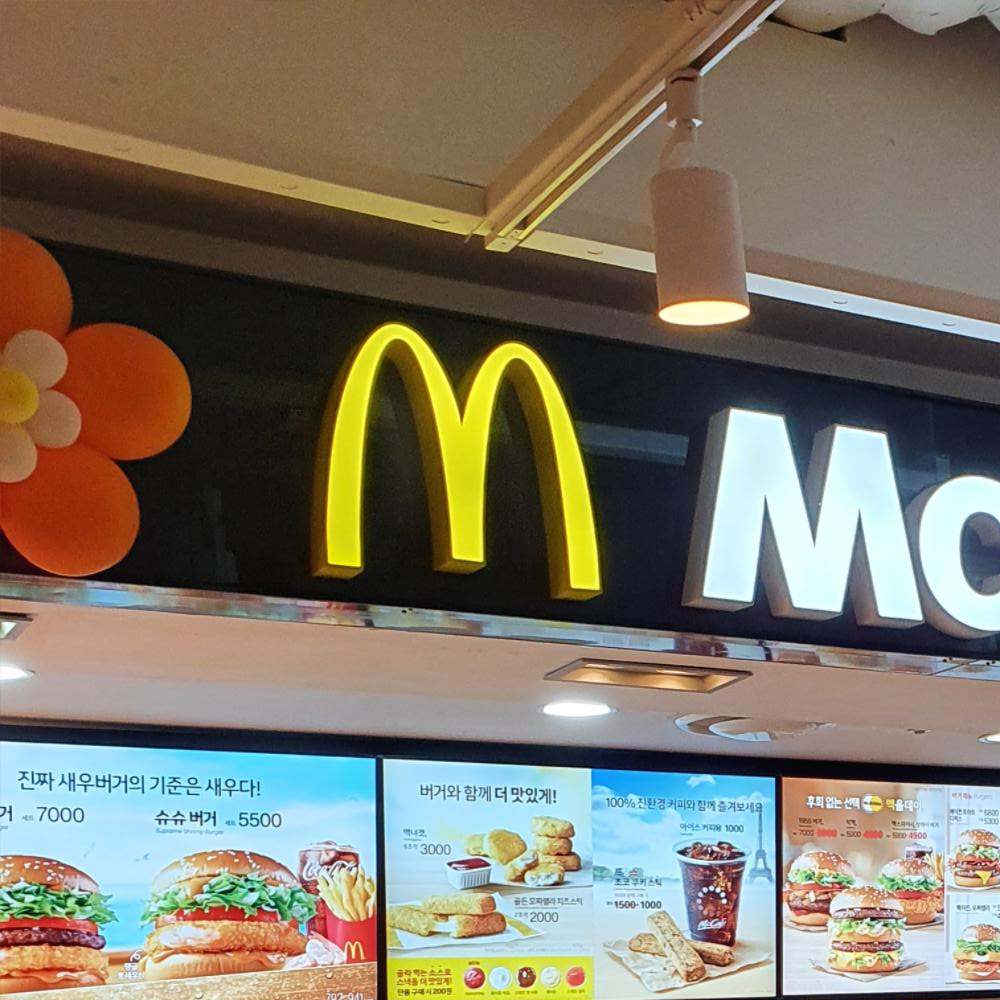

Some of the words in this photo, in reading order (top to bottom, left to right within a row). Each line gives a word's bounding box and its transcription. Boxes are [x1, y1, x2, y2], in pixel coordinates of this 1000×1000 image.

[17, 770, 55, 791] 진짜
[58, 771, 145, 794] 새우버거의
[149, 776, 202, 796] 기준은
[205, 777, 261, 798] 새우다!
[419, 783, 460, 801] 버거와
[463, 785, 492, 802] 함께
[495, 786, 508, 803] 더
[511, 787, 557, 804] 맛있게!
[606, 797, 636, 809] 100%
[637, 798, 666, 810] 친환경
[667, 799, 695, 811] 커피와
[697, 800, 716, 812] 함께
[717, 801, 763, 813] 즐겨보세요
[36, 806, 85, 823] 7000
[154, 809, 187, 826] 슈슈
[189, 810, 217, 827] 버거
[239, 812, 282, 828] 5500
[725, 824, 744, 833] 1000
[420, 843, 451, 855] 3000
[530, 911, 559, 922] 2000
